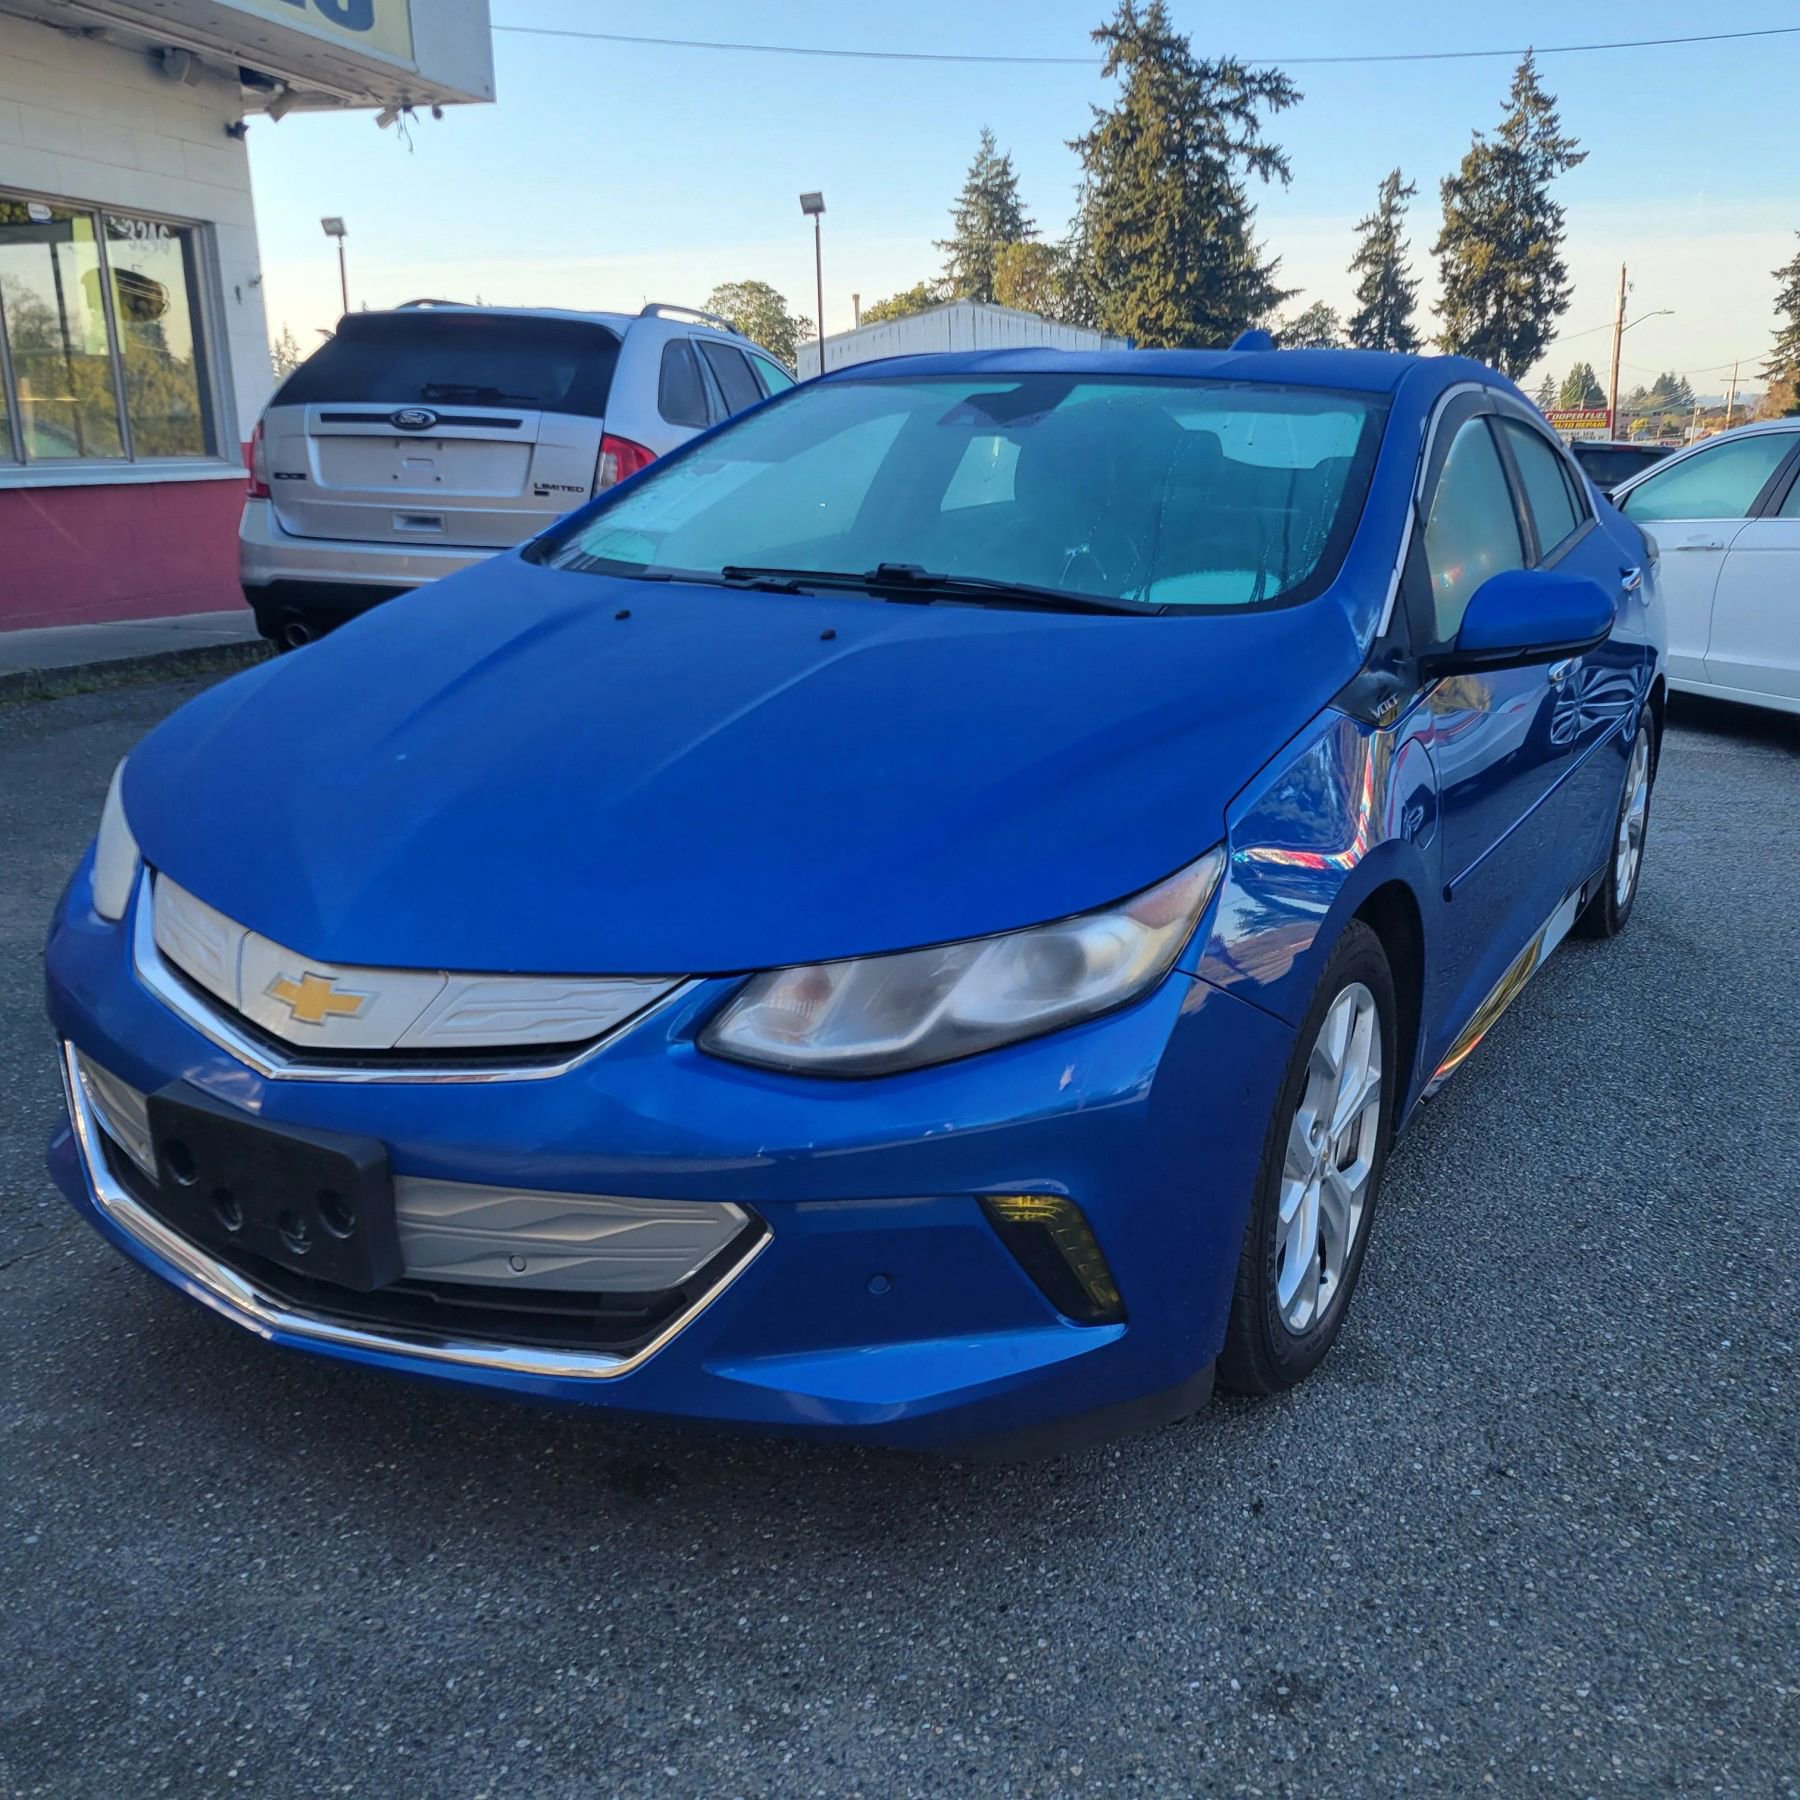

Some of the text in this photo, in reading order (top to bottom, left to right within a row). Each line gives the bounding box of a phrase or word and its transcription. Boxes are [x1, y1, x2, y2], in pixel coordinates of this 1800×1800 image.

[400, 413, 425, 424] Ford
[1545, 412, 1608, 420] COOPER FUEL
[1553, 421, 1607, 429] AUTO REPAIR
[534, 482, 584, 493] LIMITED
[1368, 692, 1398, 719] VOLT
